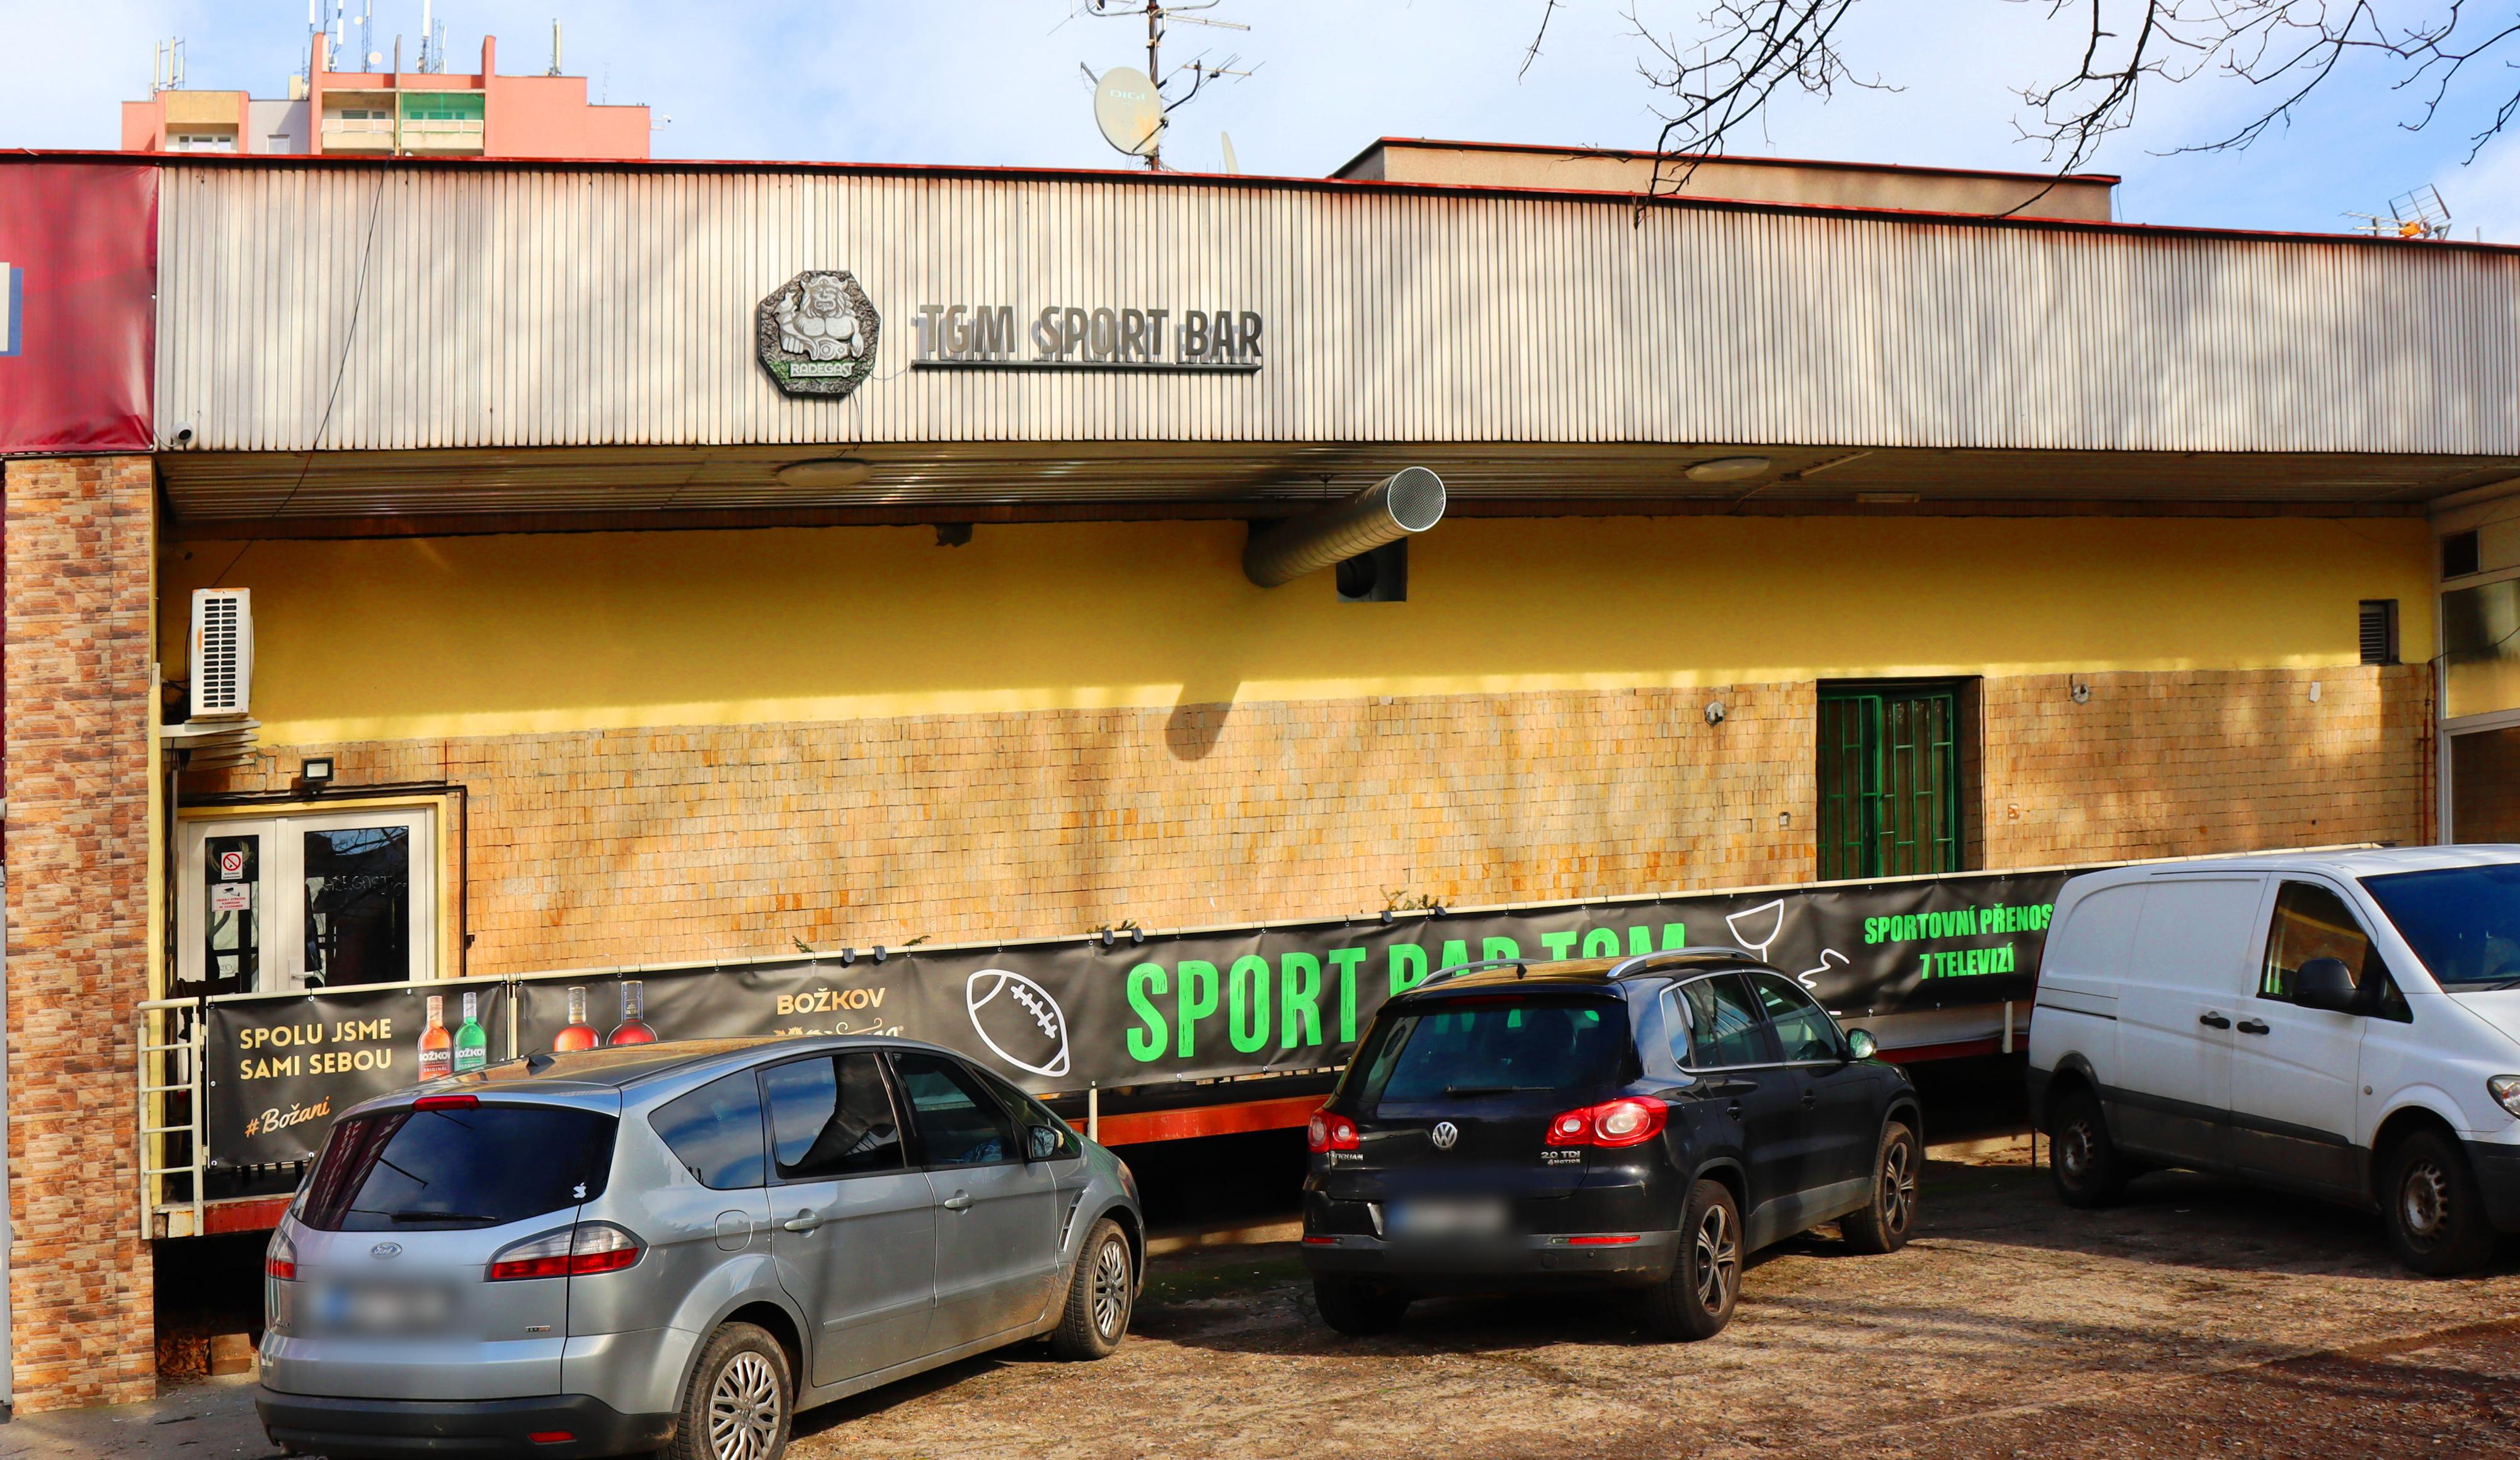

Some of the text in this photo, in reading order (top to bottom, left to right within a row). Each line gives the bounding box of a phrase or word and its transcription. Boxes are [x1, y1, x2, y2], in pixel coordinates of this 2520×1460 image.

[1109, 89, 1145, 100] DIGI
[919, 305, 1262, 356] TGM SPORT BAR
[790, 362, 856, 377] RADEGAST
[1864, 903, 2055, 944] SPORTOVNÍ PŘENOS
[1920, 942, 2015, 979] 7 TELEVIZÍ
[777, 988, 886, 1015] BOŽKOV
[1126, 947, 1366, 1062] SPORT
[240, 1018, 392, 1049] SPOLU JSME
[240, 1049, 392, 1080] SAMI SEBOU
[244, 1095, 330, 1138] #Božani
